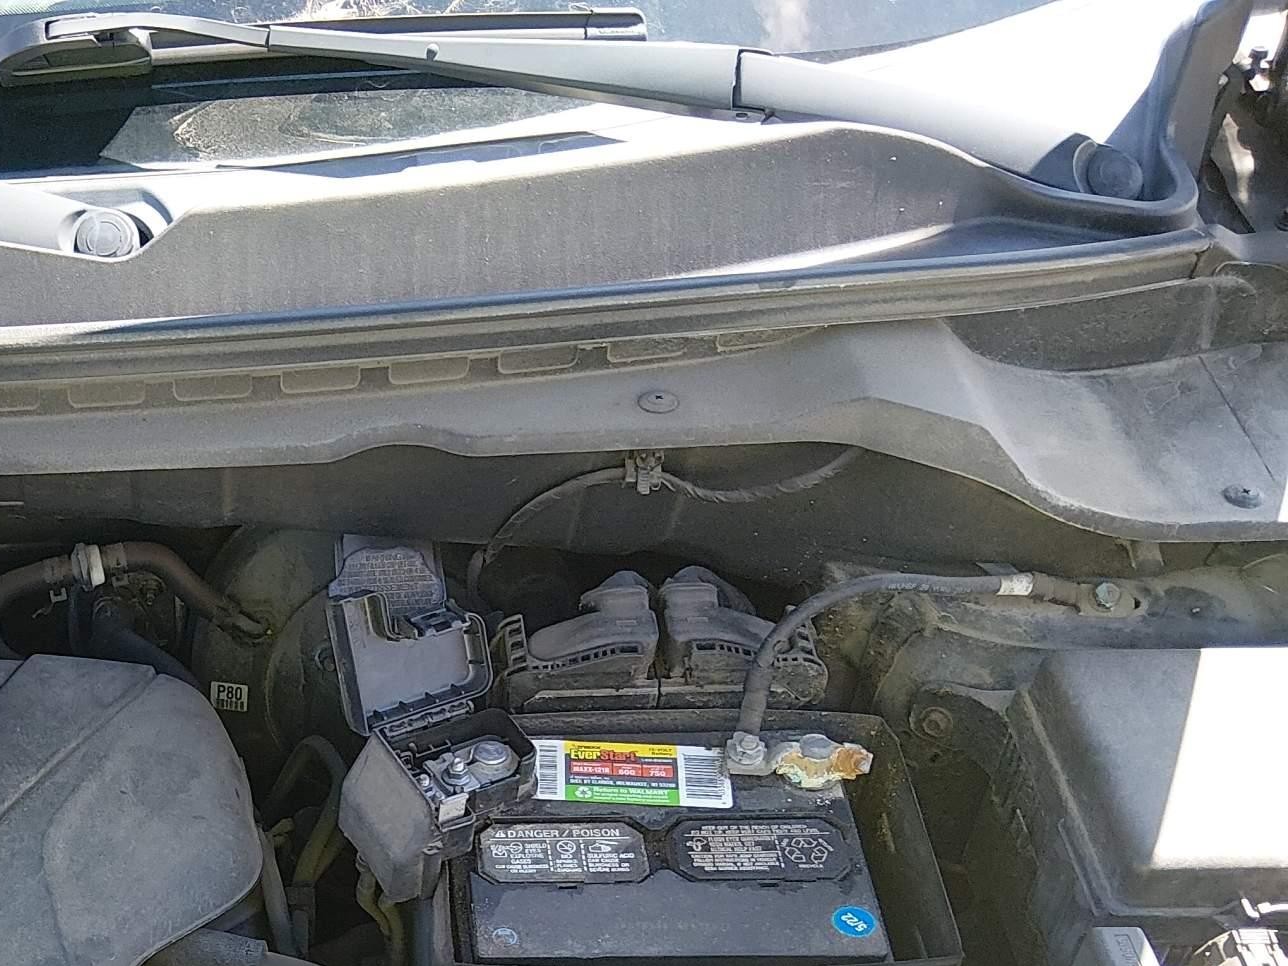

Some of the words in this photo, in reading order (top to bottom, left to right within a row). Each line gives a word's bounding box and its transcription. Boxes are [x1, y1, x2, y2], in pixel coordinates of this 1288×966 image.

[216, 684, 243, 701] P80
[570, 749, 636, 762] EverStart
[507, 830, 559, 838] DANGER
[573, 829, 620, 837] POISON
[841, 912, 867, 932] 5/22
